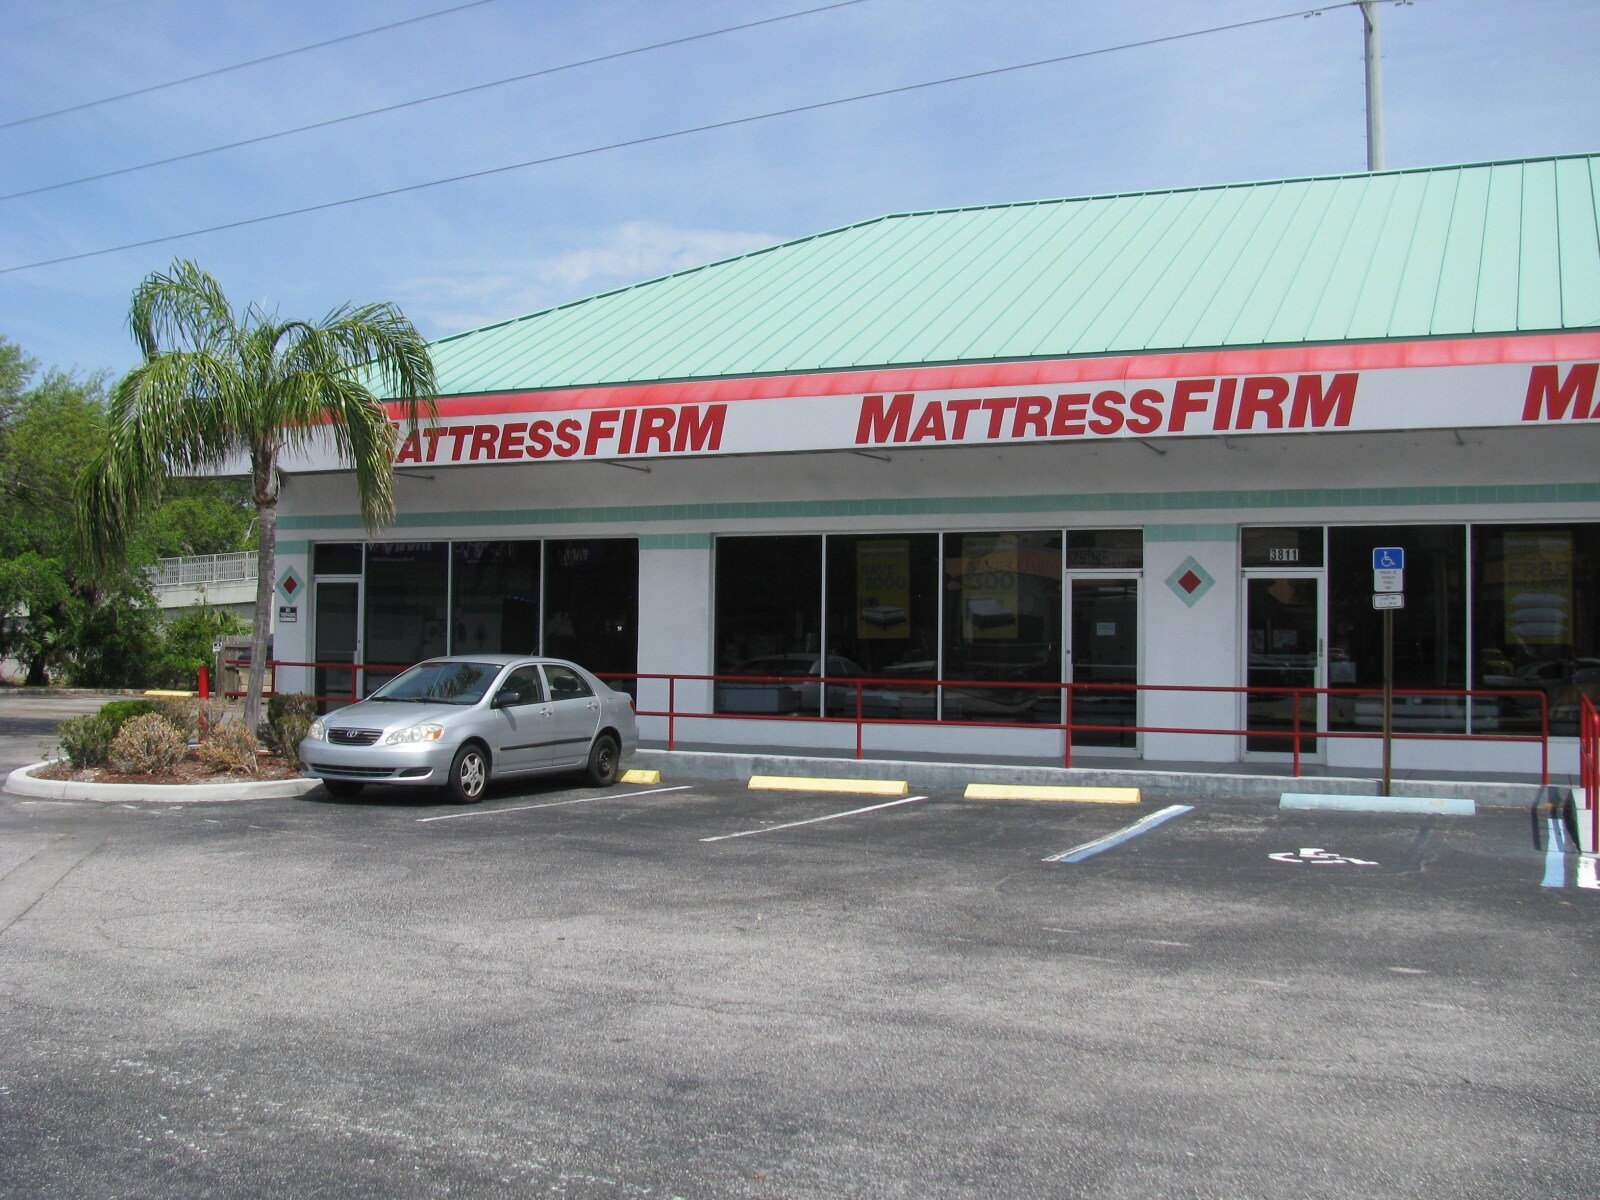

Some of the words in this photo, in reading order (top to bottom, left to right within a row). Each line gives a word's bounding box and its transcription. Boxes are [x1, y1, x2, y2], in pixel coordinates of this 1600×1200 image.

[1521, 363, 1600, 421] M
[387, 404, 727, 463] ATTRESSFIRM
[1270, 548, 1298, 561] 3811
